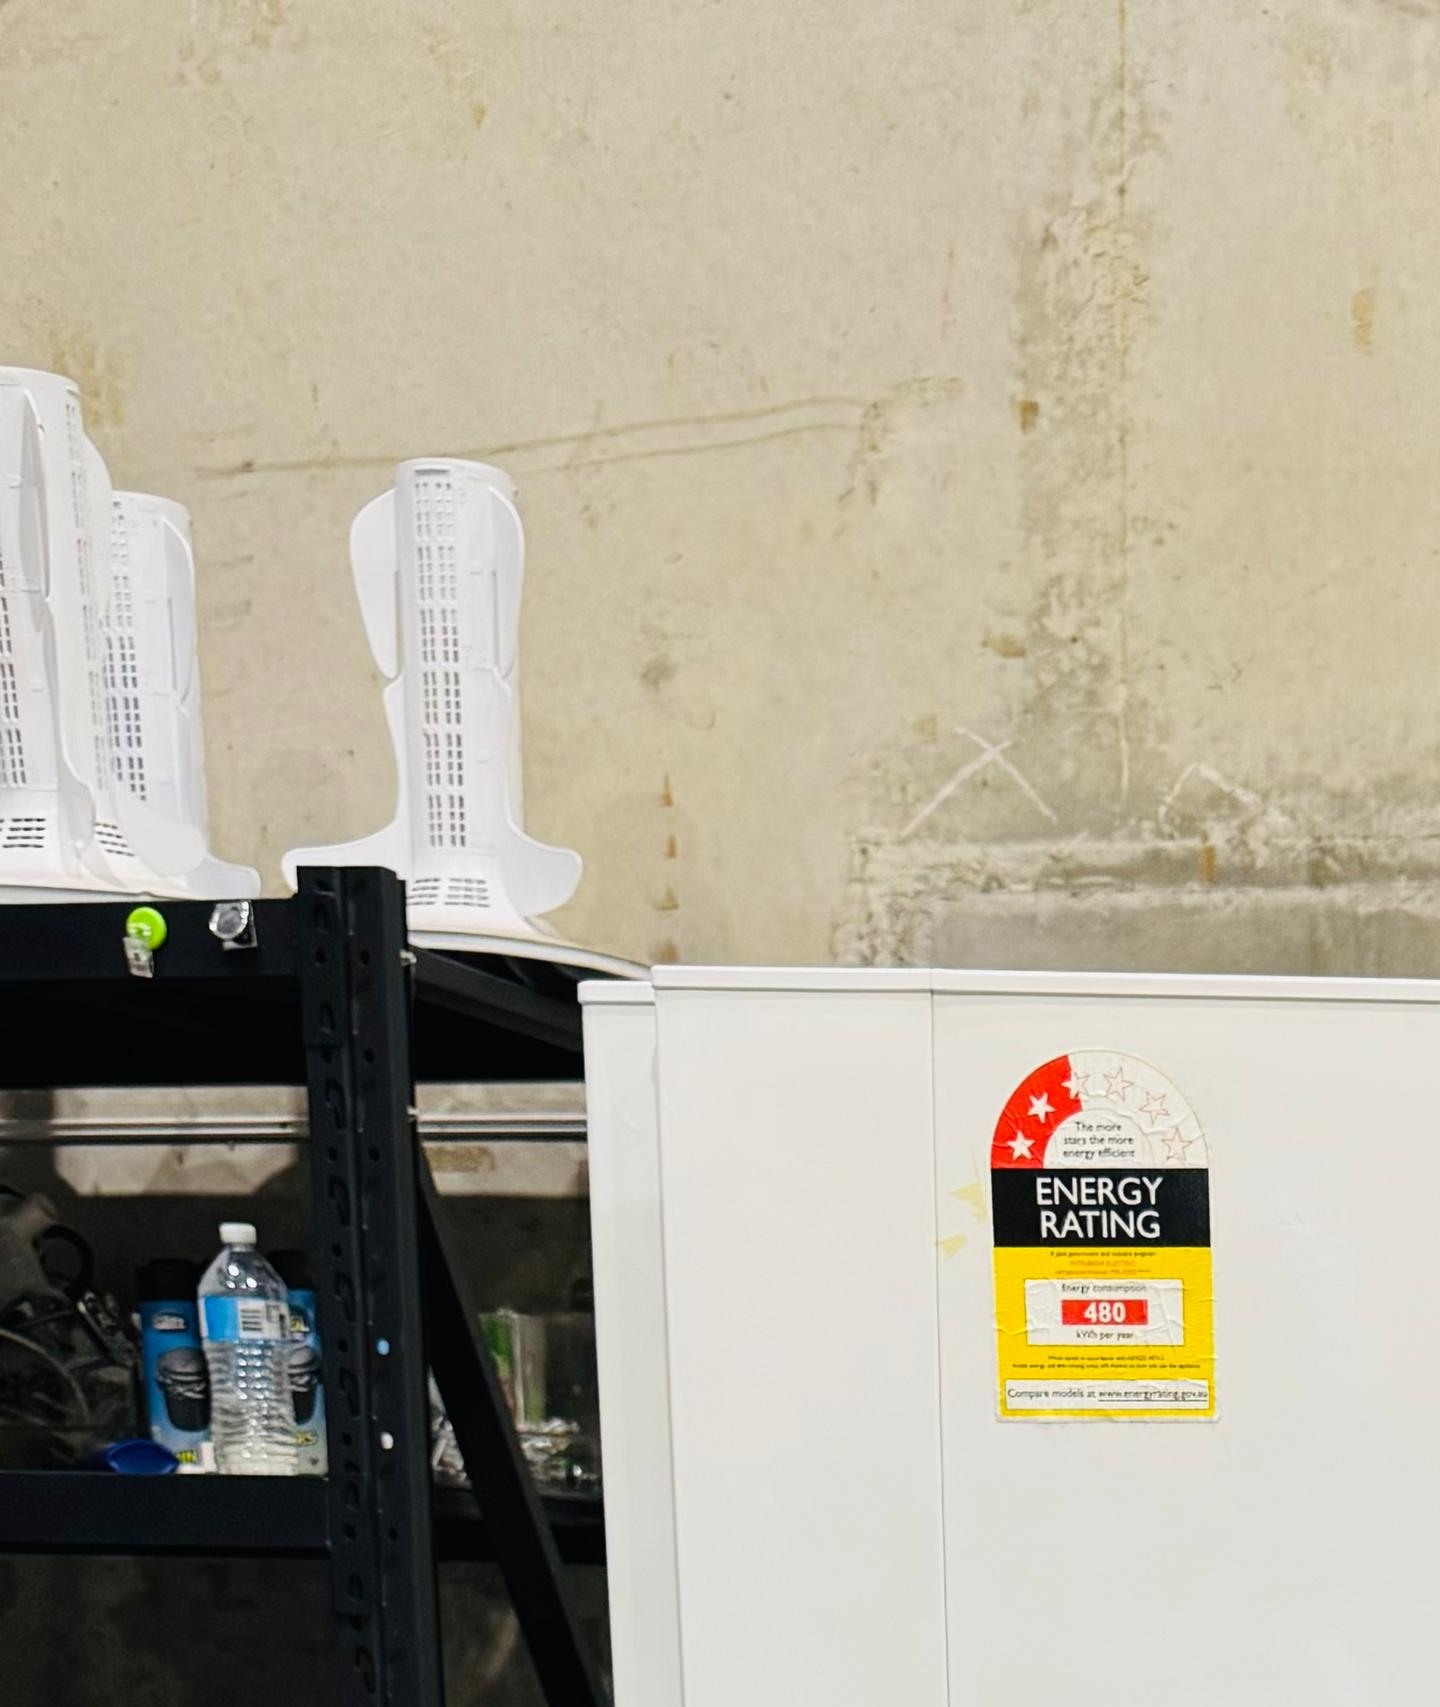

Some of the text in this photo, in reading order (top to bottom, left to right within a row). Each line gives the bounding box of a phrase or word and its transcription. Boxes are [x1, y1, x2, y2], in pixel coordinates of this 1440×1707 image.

[1074, 1121, 1122, 1132] The more
[1089, 1134, 1105, 1145] the
[1107, 1136, 1134, 1145] more
[1063, 1149, 1095, 1160] energy
[1036, 1176, 1164, 1206] ENERGY
[1040, 1209, 1160, 1239] RATING
[1061, 1283, 1147, 1294] Energy consumption
[1083, 1301, 1127, 1323] 480
[1100, 1331, 1114, 1340] per
[1117, 1331, 1134, 1340] year
[1007, 1388, 1050, 1400] Compare
[1052, 1387, 1085, 1398] models
[1087, 1390, 1097, 1398] at
